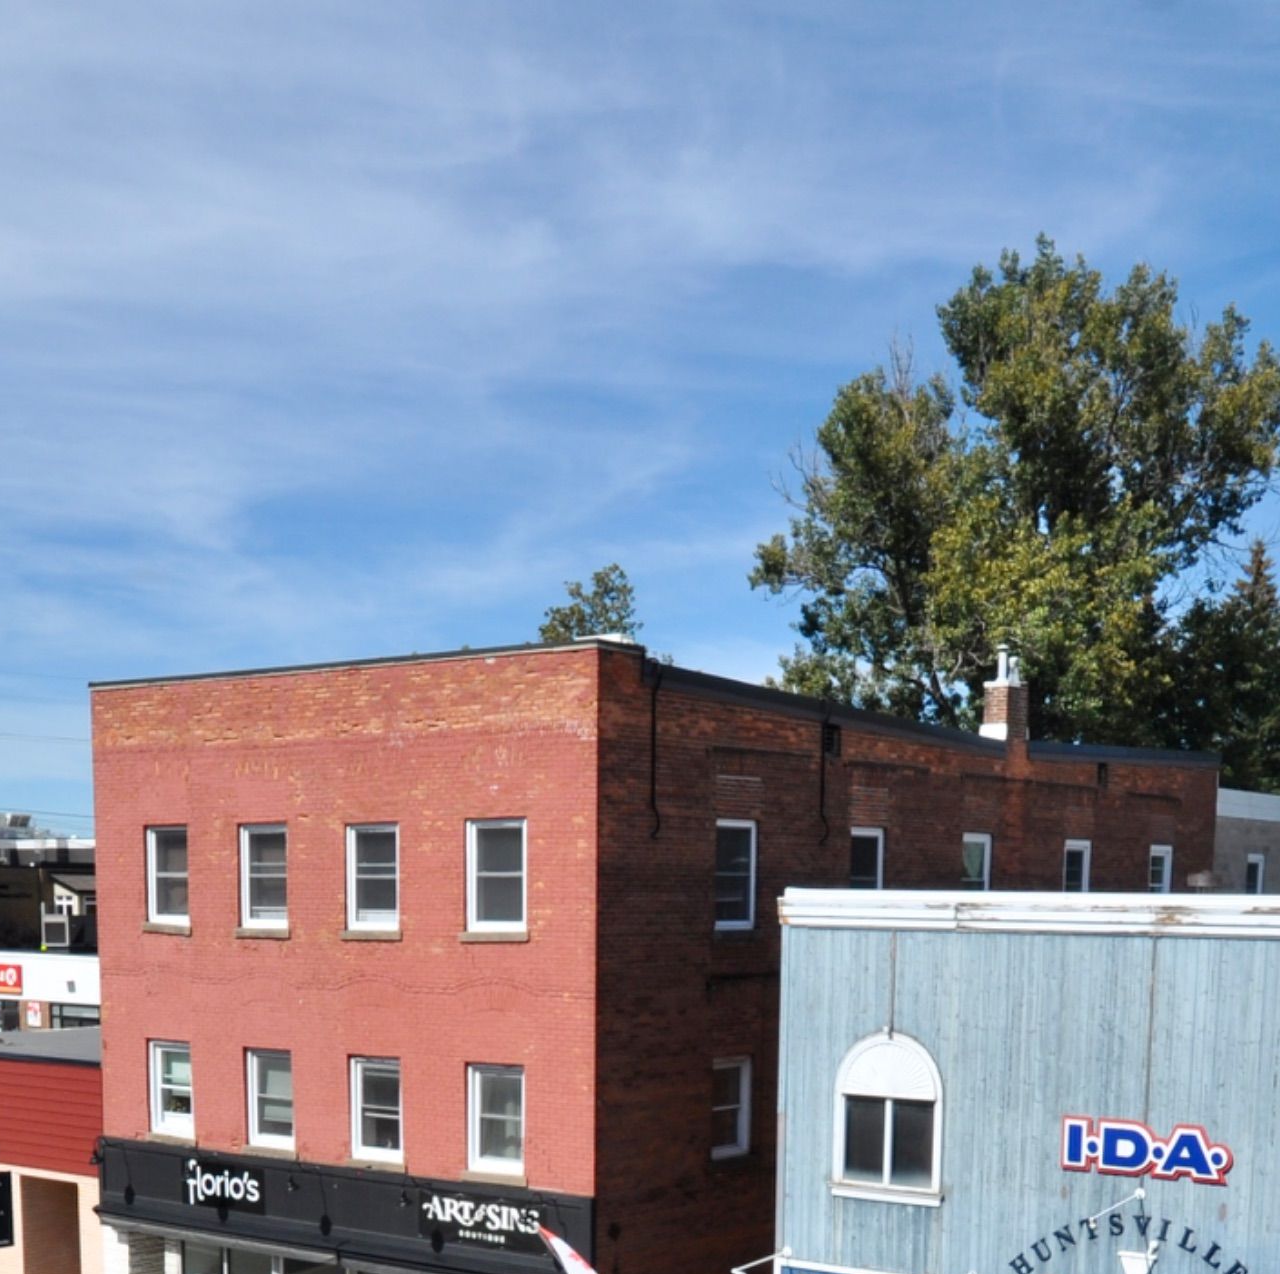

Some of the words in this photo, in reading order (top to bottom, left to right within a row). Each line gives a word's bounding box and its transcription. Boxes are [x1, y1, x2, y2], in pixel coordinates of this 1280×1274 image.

[186, 1158, 260, 1205] florio's
[422, 1195, 475, 1227] ART
[486, 1204, 540, 1235] SINS
[458, 1229, 506, 1244] BOUTIQUE
